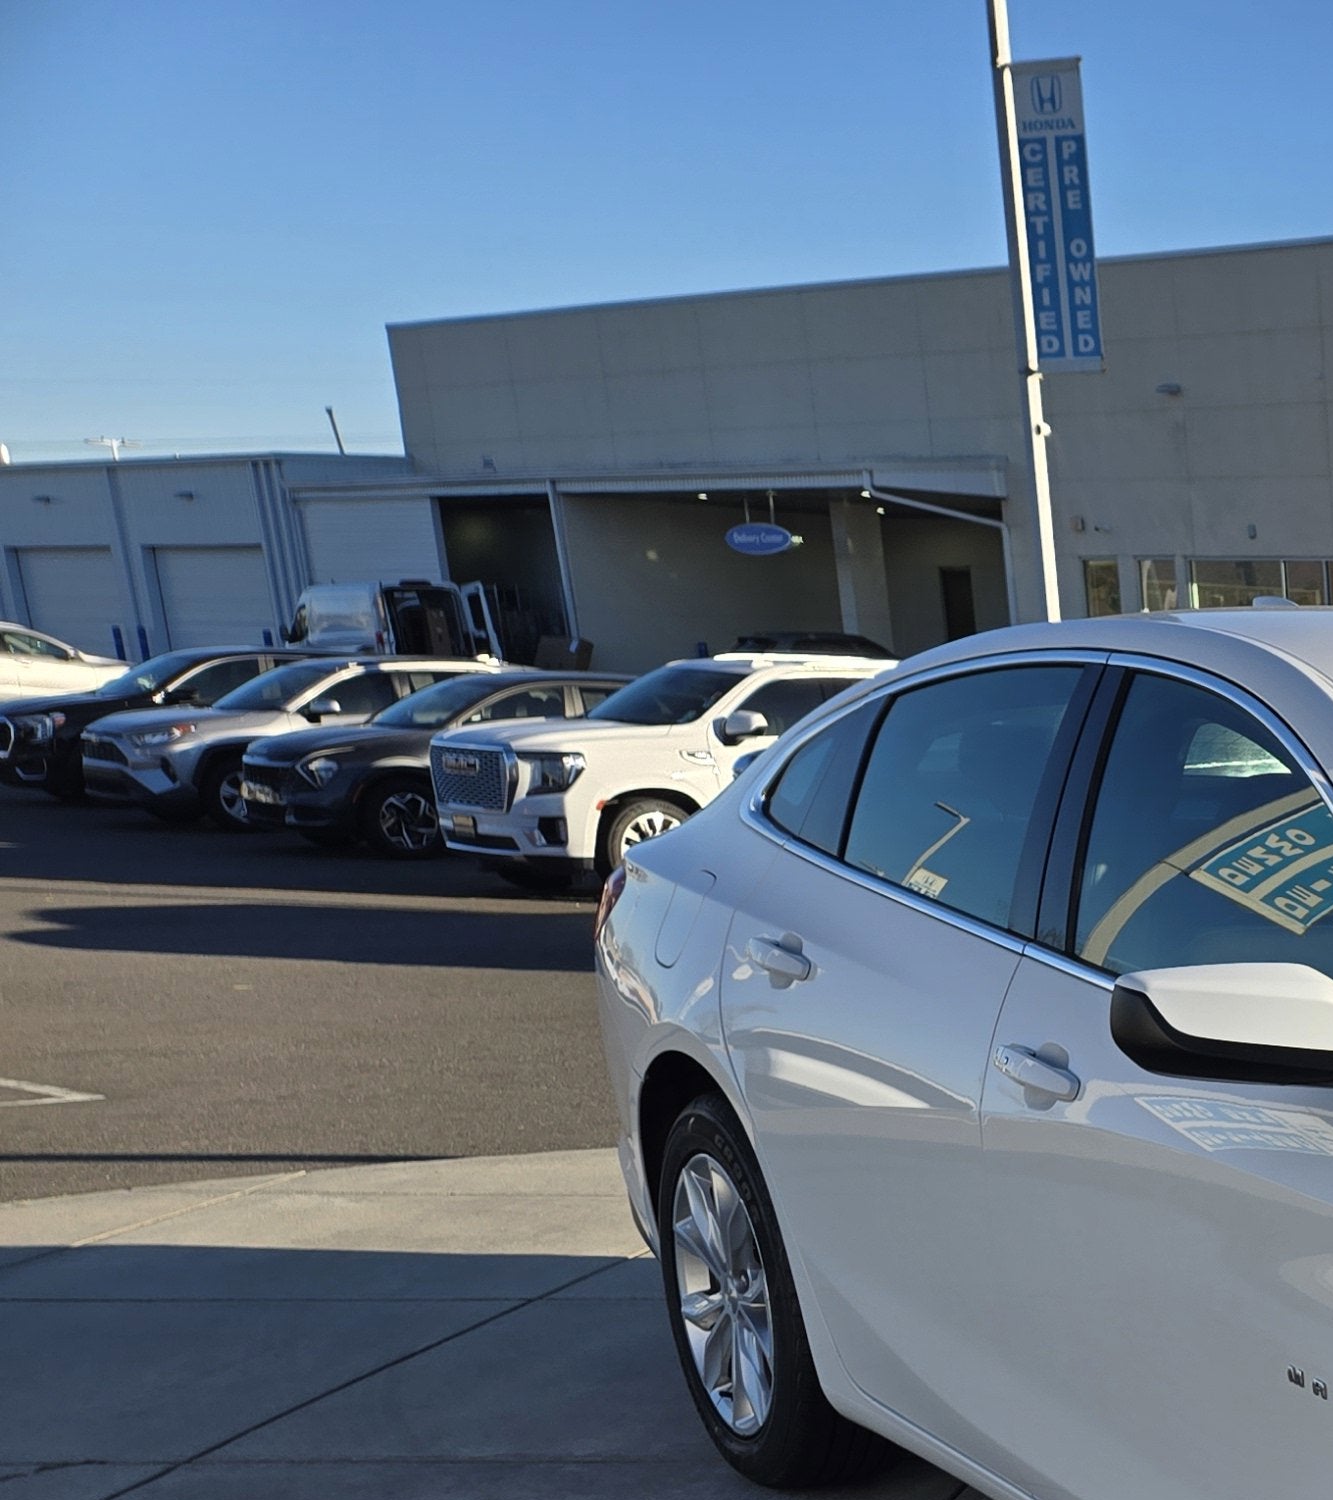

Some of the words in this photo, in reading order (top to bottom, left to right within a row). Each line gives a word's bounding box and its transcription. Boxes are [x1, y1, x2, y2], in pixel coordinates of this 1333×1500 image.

[1022, 118, 1076, 132] HONDA
[1062, 141, 1082, 210] PRE
[1023, 143, 1060, 354] CERTIFIED
[1070, 238, 1096, 353] OWNED
